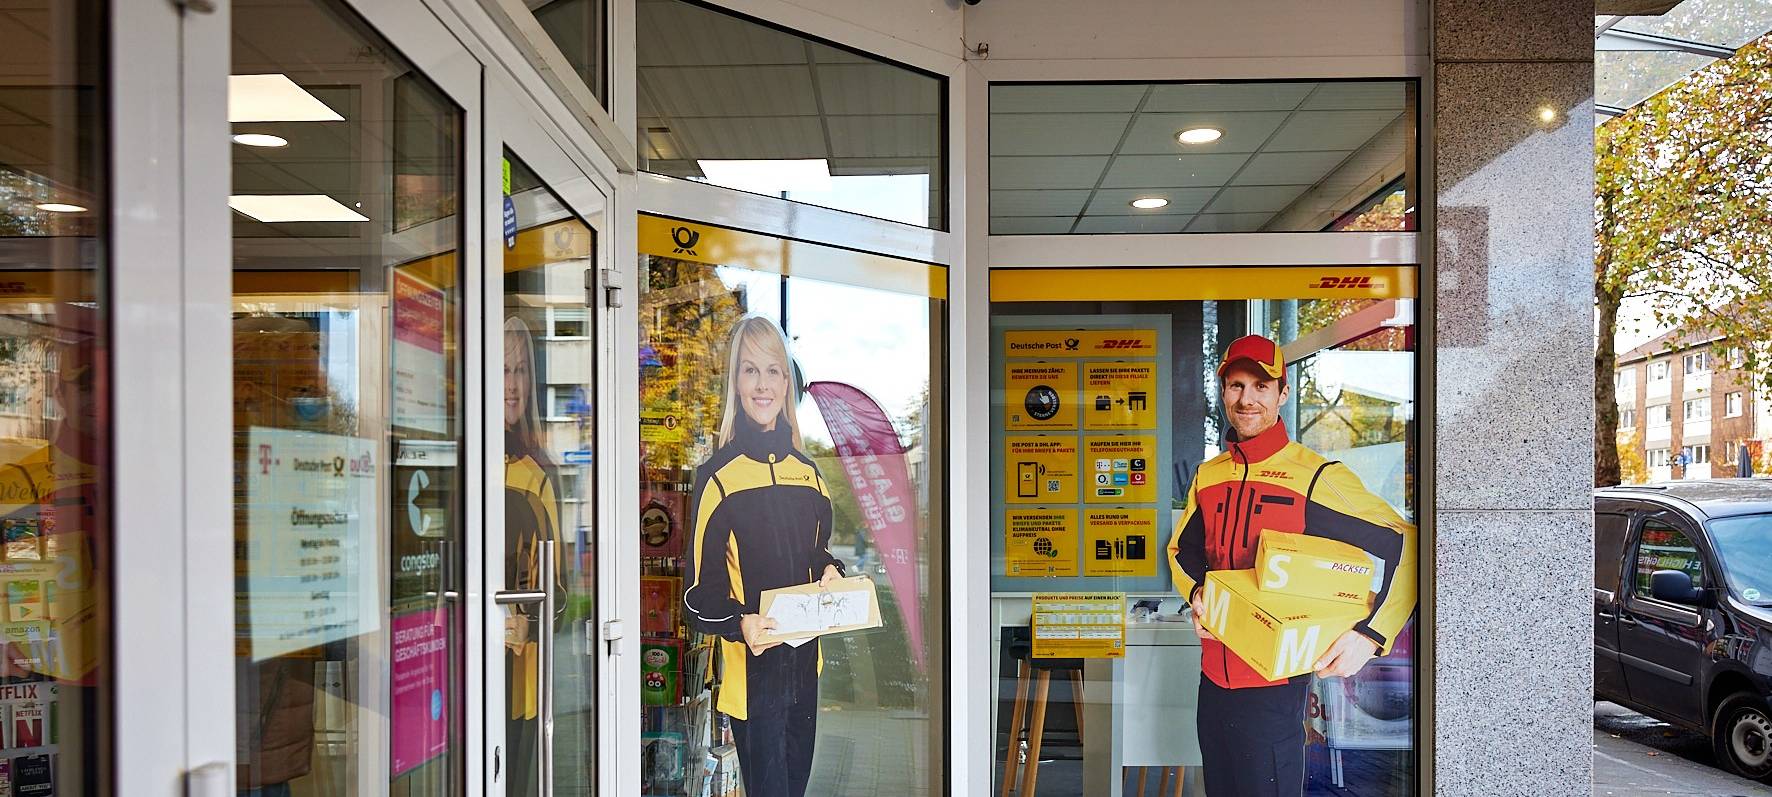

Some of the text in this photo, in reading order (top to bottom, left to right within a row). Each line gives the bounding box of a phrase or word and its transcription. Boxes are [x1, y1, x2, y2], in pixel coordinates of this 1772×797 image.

[1319, 277, 1373, 289] DHL
[1010, 341, 1062, 350] Deutsche Post
[1102, 340, 1143, 349] DHL
[1259, 470, 1288, 479] DHL
[1265, 554, 1292, 589] S
[1331, 562, 1370, 575] PACKSET
[1336, 591, 1361, 600] DHL
[1201, 579, 1231, 636] M
[1253, 612, 1272, 629] DHL
[5, 625, 41, 637] amazon
[395, 621, 434, 645] BERATUNG FÜR
[395, 637, 447, 662] GESCHÄFTSKUNDEN
[1275, 624, 1321, 678] M
[16, 709, 42, 717] NETFLIX
